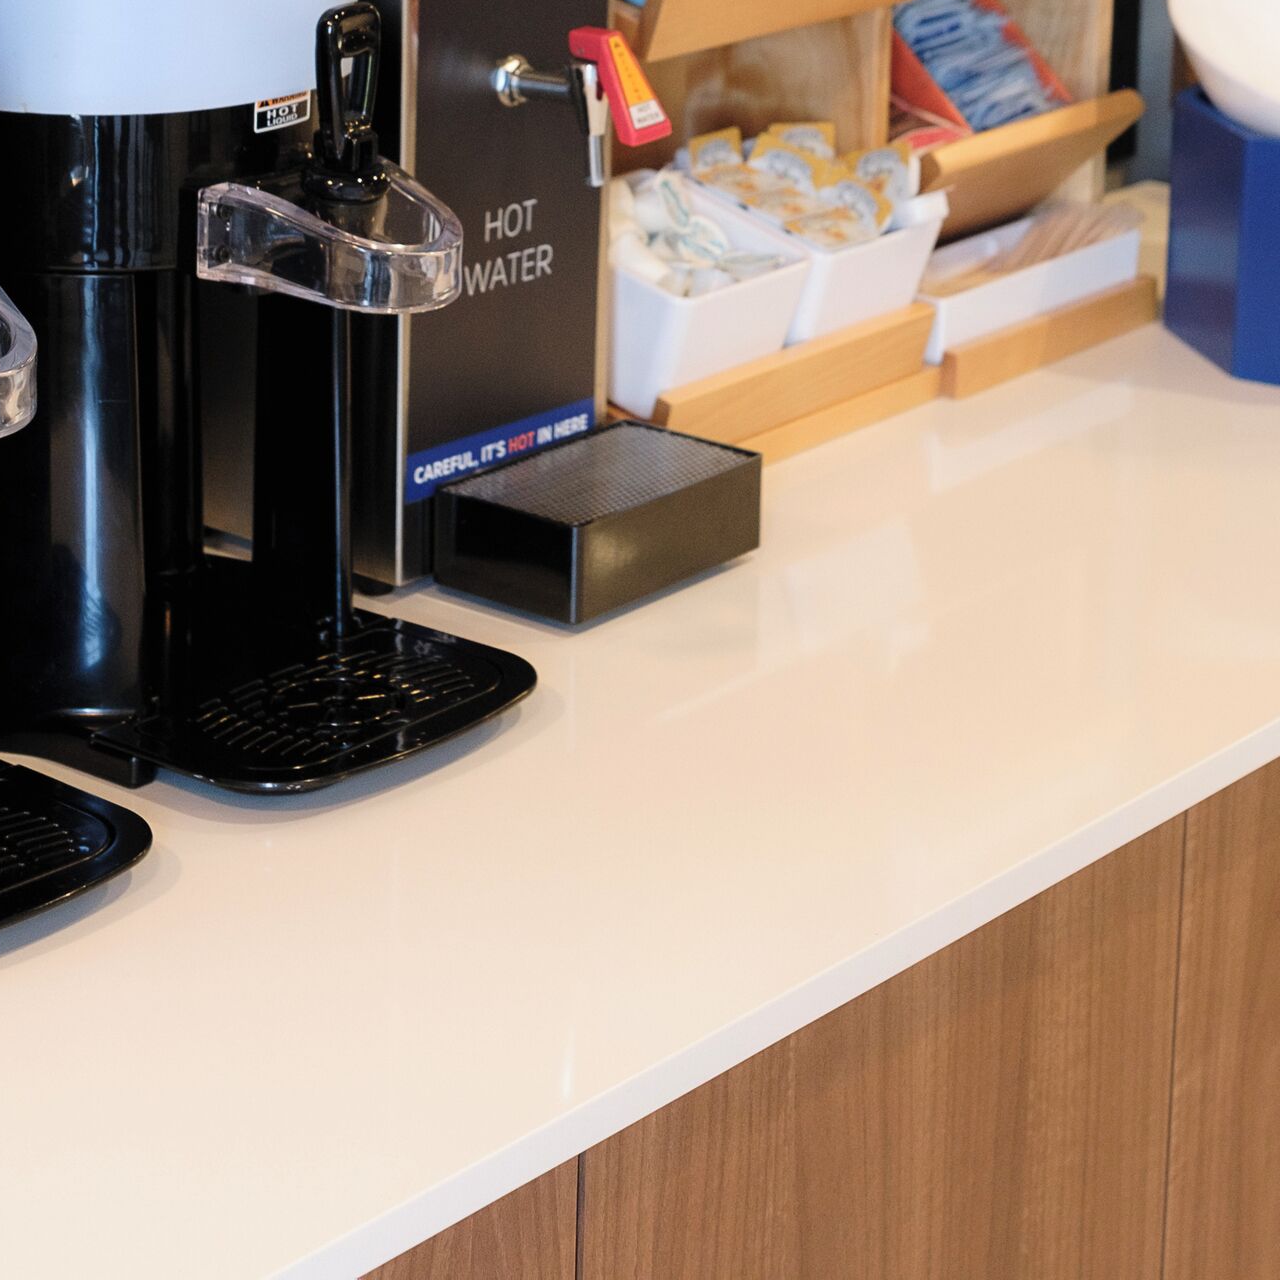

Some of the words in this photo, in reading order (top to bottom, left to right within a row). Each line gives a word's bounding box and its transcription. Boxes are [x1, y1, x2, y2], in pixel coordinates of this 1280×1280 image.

[266, 103, 299, 120] HOT
[266, 113, 298, 128] LIQUID
[484, 198, 538, 243] HOT
[463, 243, 555, 297] WATER
[413, 451, 480, 485] CAREFUL,
[480, 439, 507, 464] IT'S
[507, 431, 536, 454] HOT
[536, 424, 553, 446] IN
[554, 413, 589, 439] HERE
